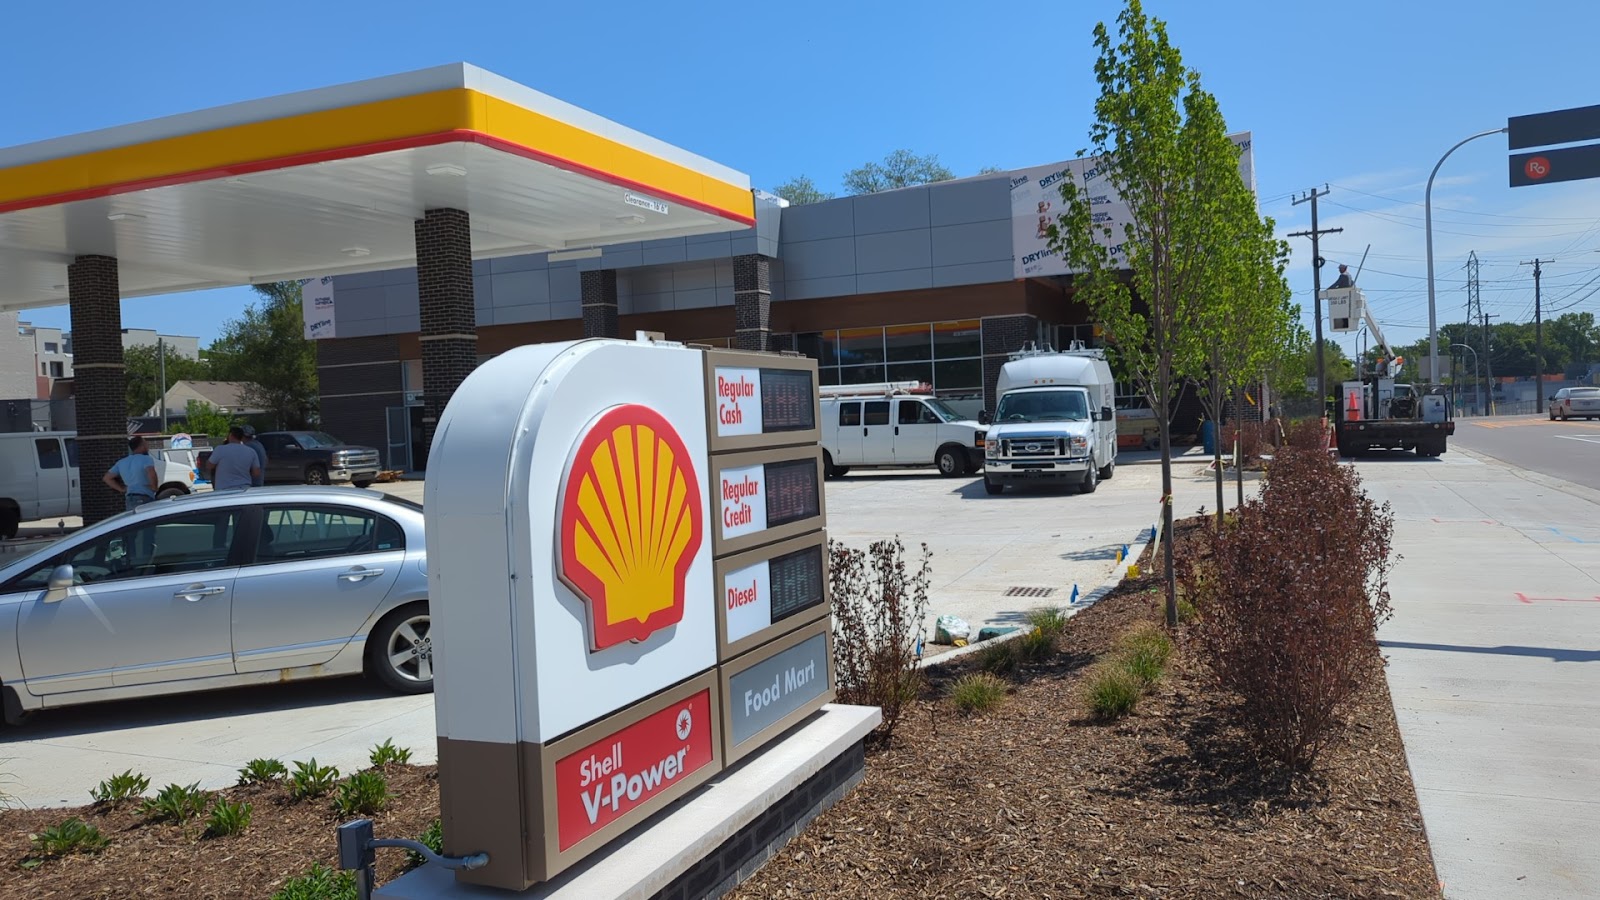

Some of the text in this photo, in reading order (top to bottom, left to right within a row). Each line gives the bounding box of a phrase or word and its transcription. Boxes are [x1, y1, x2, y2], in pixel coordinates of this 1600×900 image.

[625, 193, 650, 208] Clearance
[718, 375, 754, 403] Regular
[719, 403, 742, 425] Cash
[722, 475, 759, 504] Regular
[724, 505, 752, 528] Credit
[728, 579, 757, 611] Diesel
[744, 659, 815, 717] Food Mart
[580, 741, 623, 787] Shell
[580, 747, 687, 825] V-Power
